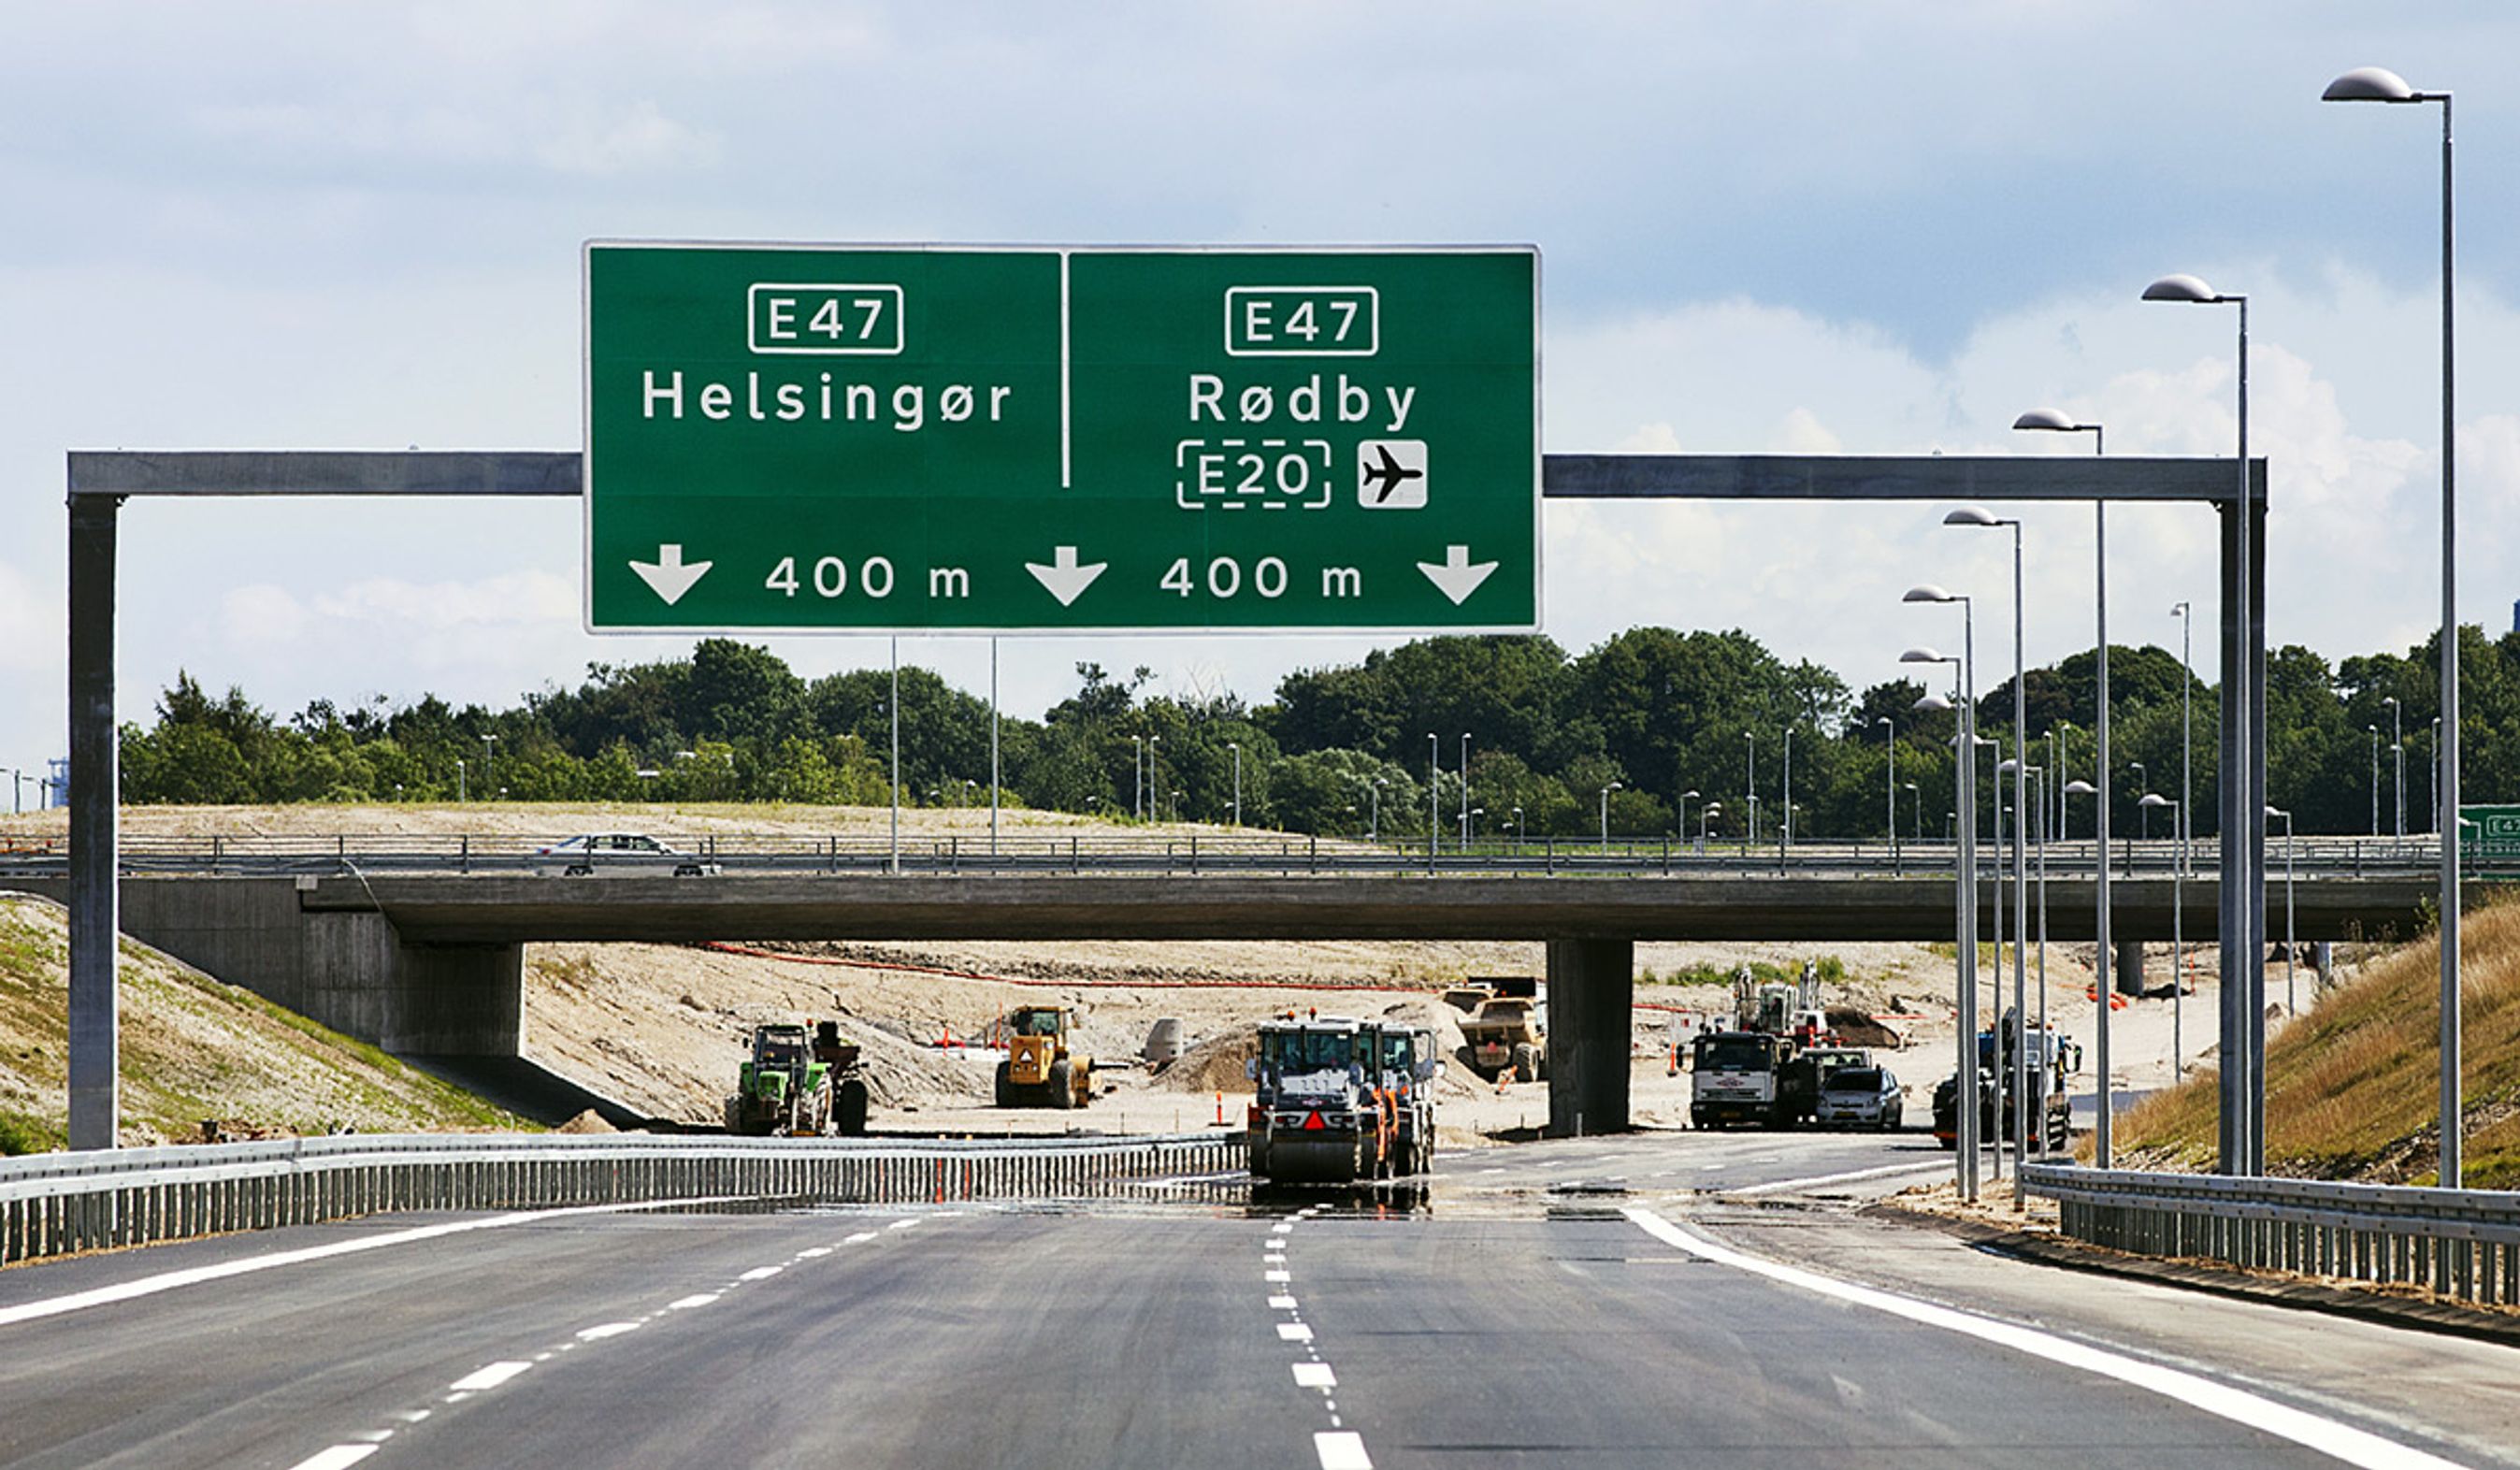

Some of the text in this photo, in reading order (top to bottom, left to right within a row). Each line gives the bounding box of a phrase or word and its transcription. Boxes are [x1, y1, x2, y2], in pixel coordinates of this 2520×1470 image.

[770, 298, 883, 339] E47
[1246, 301, 1358, 341] E47
[643, 370, 1011, 432] Helsingør
[1190, 374, 1416, 432] Rødby
[1199, 454, 1309, 495] E20
[765, 556, 969, 598] 400 m
[1160, 556, 1361, 598] 400 m
